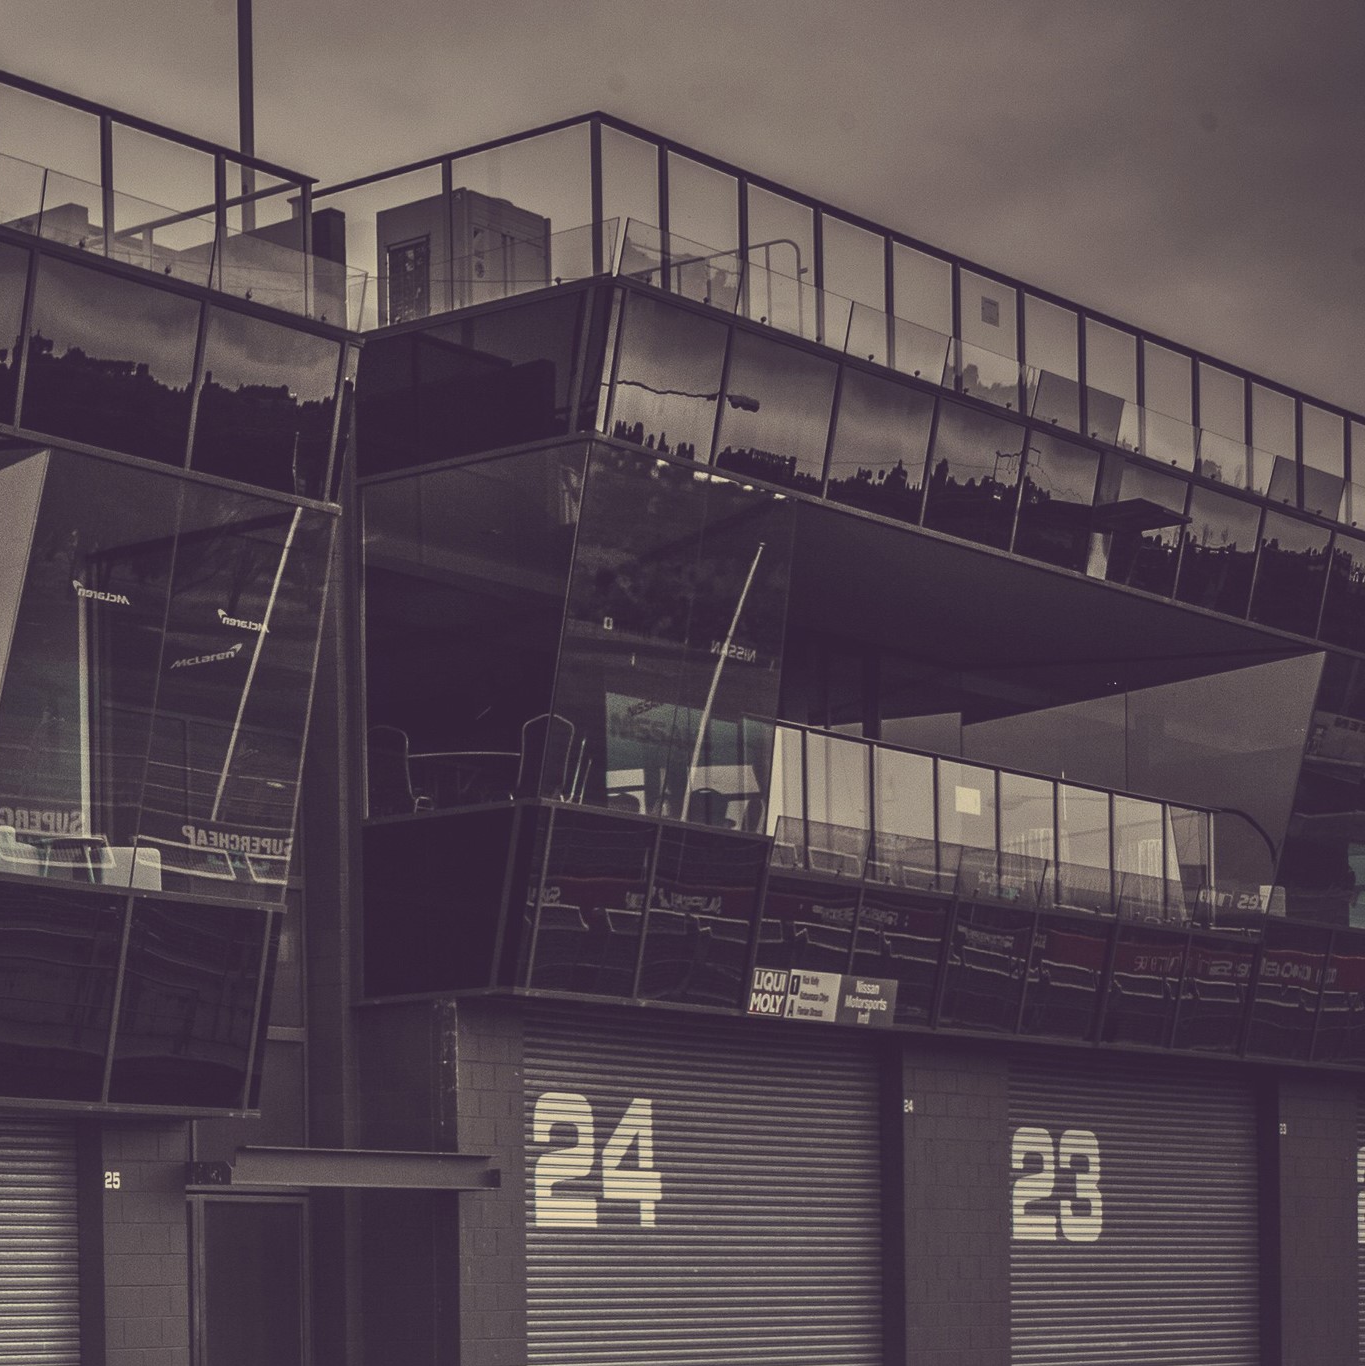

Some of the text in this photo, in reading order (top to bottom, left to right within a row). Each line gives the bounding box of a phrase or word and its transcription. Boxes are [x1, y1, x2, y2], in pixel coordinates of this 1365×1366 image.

[754, 971, 787, 992] LIQUI
[855, 980, 880, 995] Nissan
[749, 992, 784, 1013] MOLY
[787, 999, 795, 1017] A
[844, 995, 888, 1011] Motorsports
[532, 1092, 662, 1227] 24
[104, 1171, 121, 1190] 25
[1011, 1126, 1103, 1242] 23
